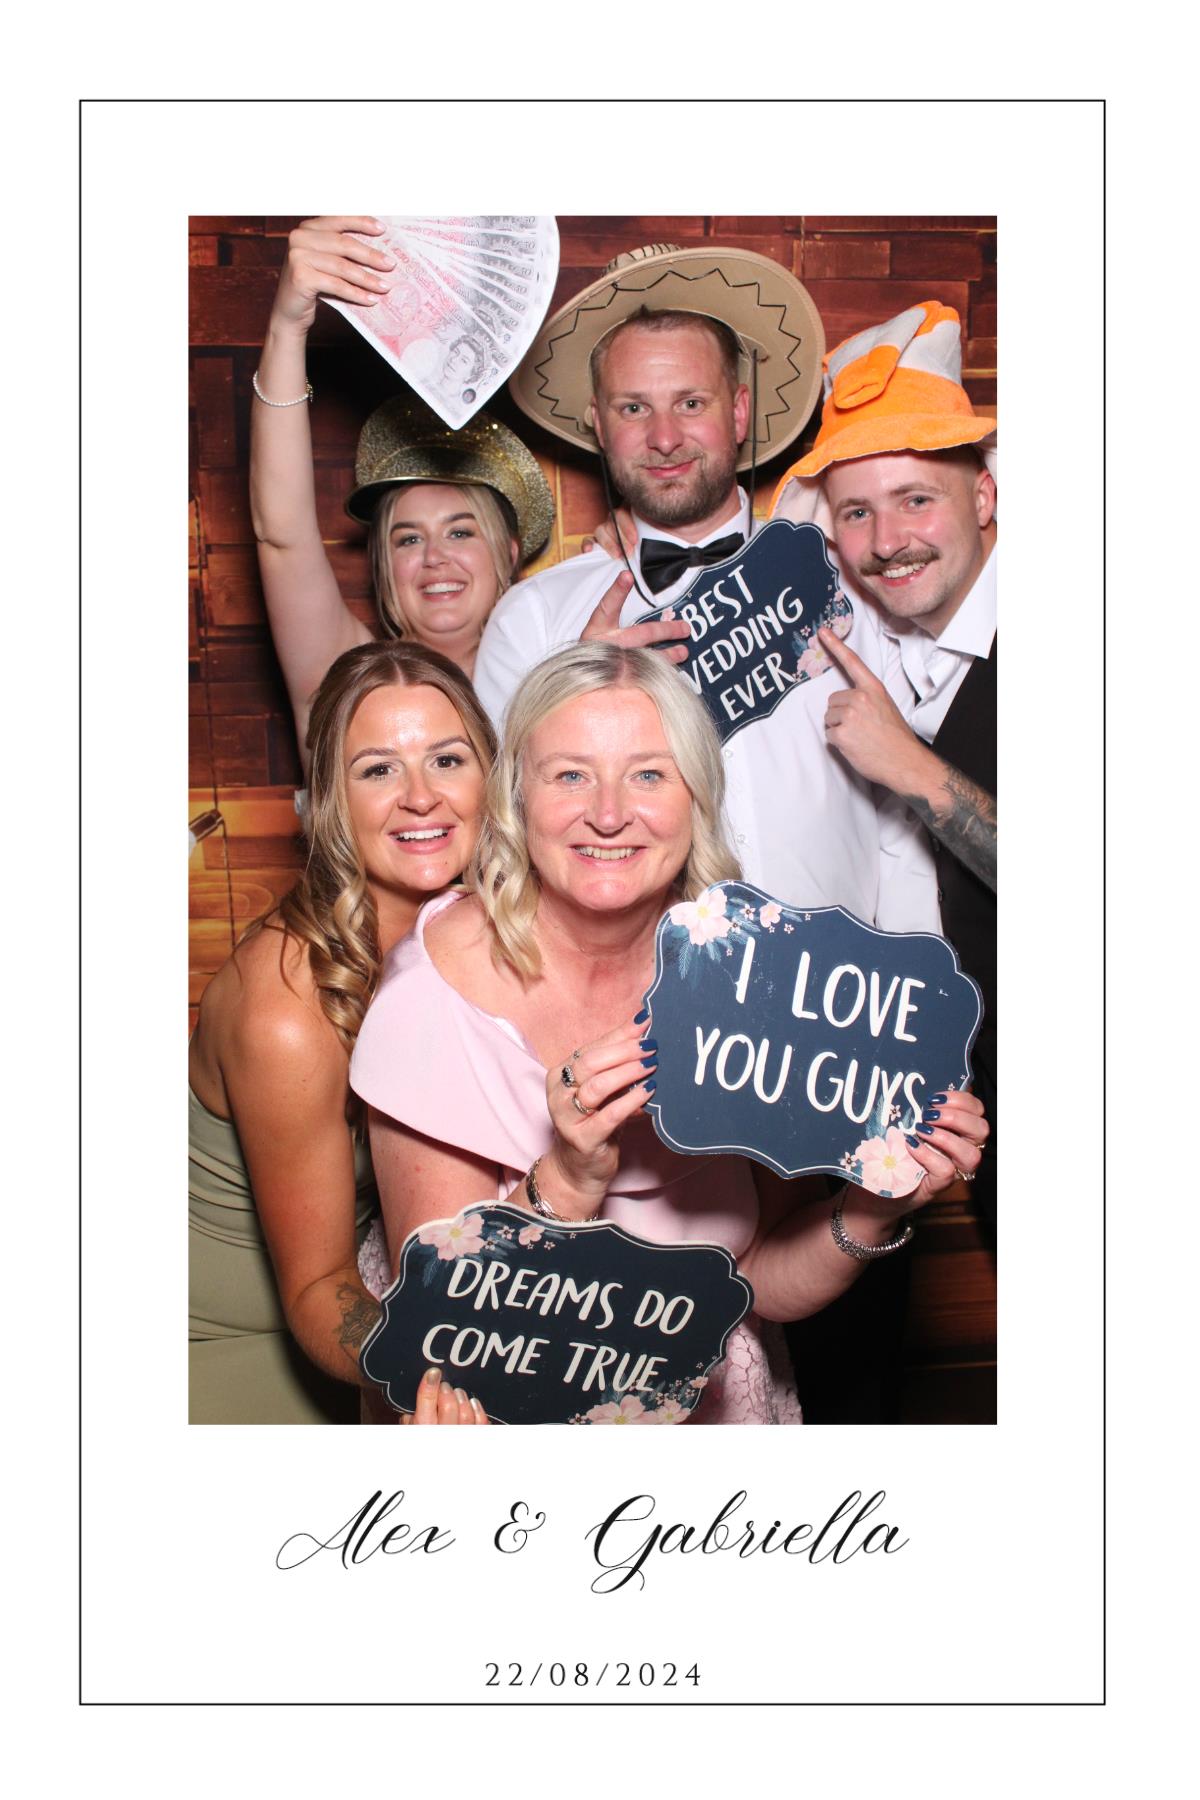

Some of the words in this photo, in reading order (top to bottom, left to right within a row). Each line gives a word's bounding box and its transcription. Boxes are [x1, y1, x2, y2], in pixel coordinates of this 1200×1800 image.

[681, 564, 754, 643] BEST
[720, 652, 795, 721] EVER
[735, 936, 756, 1004] I
[791, 951, 926, 1042] LOVE
[694, 1026, 793, 1104] YOU
[806, 1051, 926, 1135] GUYS
[447, 1258, 623, 1330] DREAMS
[633, 1289, 695, 1335] DO
[422, 1323, 550, 1375] COME
[563, 1342, 669, 1392] TRUE
